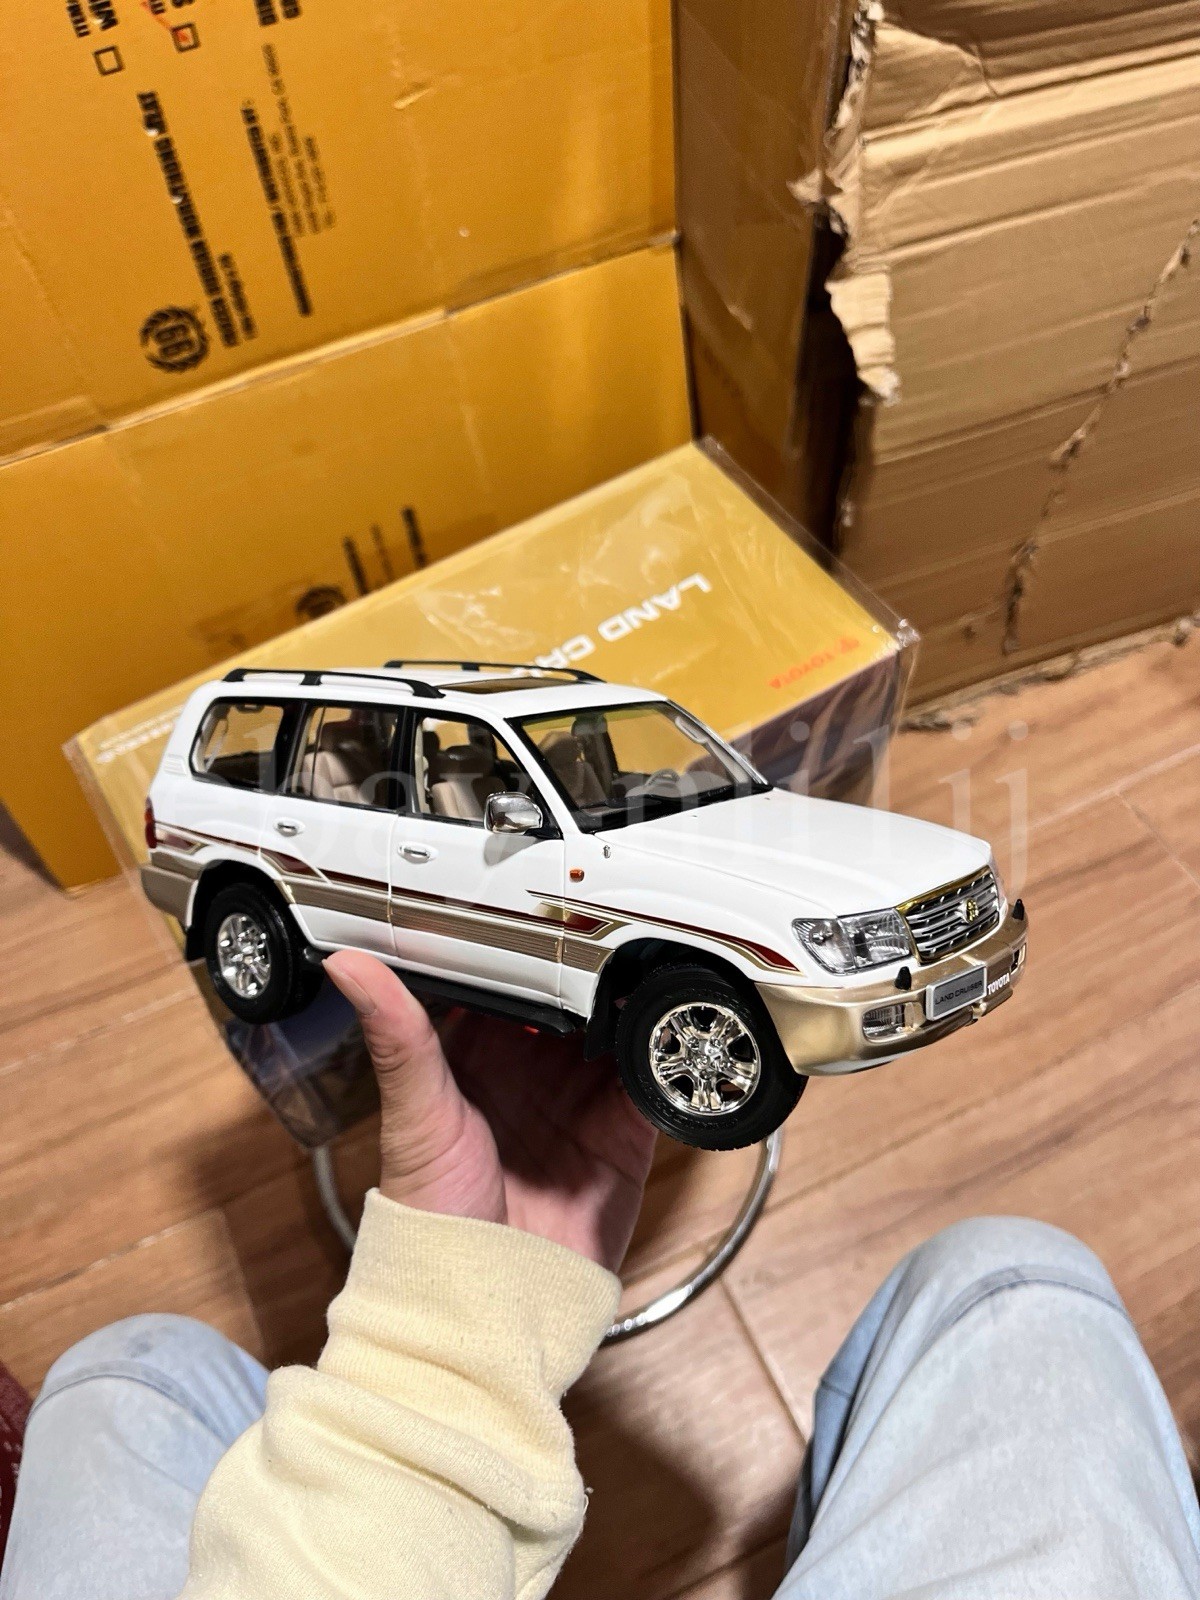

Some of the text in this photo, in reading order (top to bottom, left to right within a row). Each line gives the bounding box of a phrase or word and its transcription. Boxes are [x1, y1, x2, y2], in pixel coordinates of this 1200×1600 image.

[597, 571, 713, 642] LAND
[954, 980, 983, 999] CRUISER
[987, 972, 1010, 995] TOYOTA
